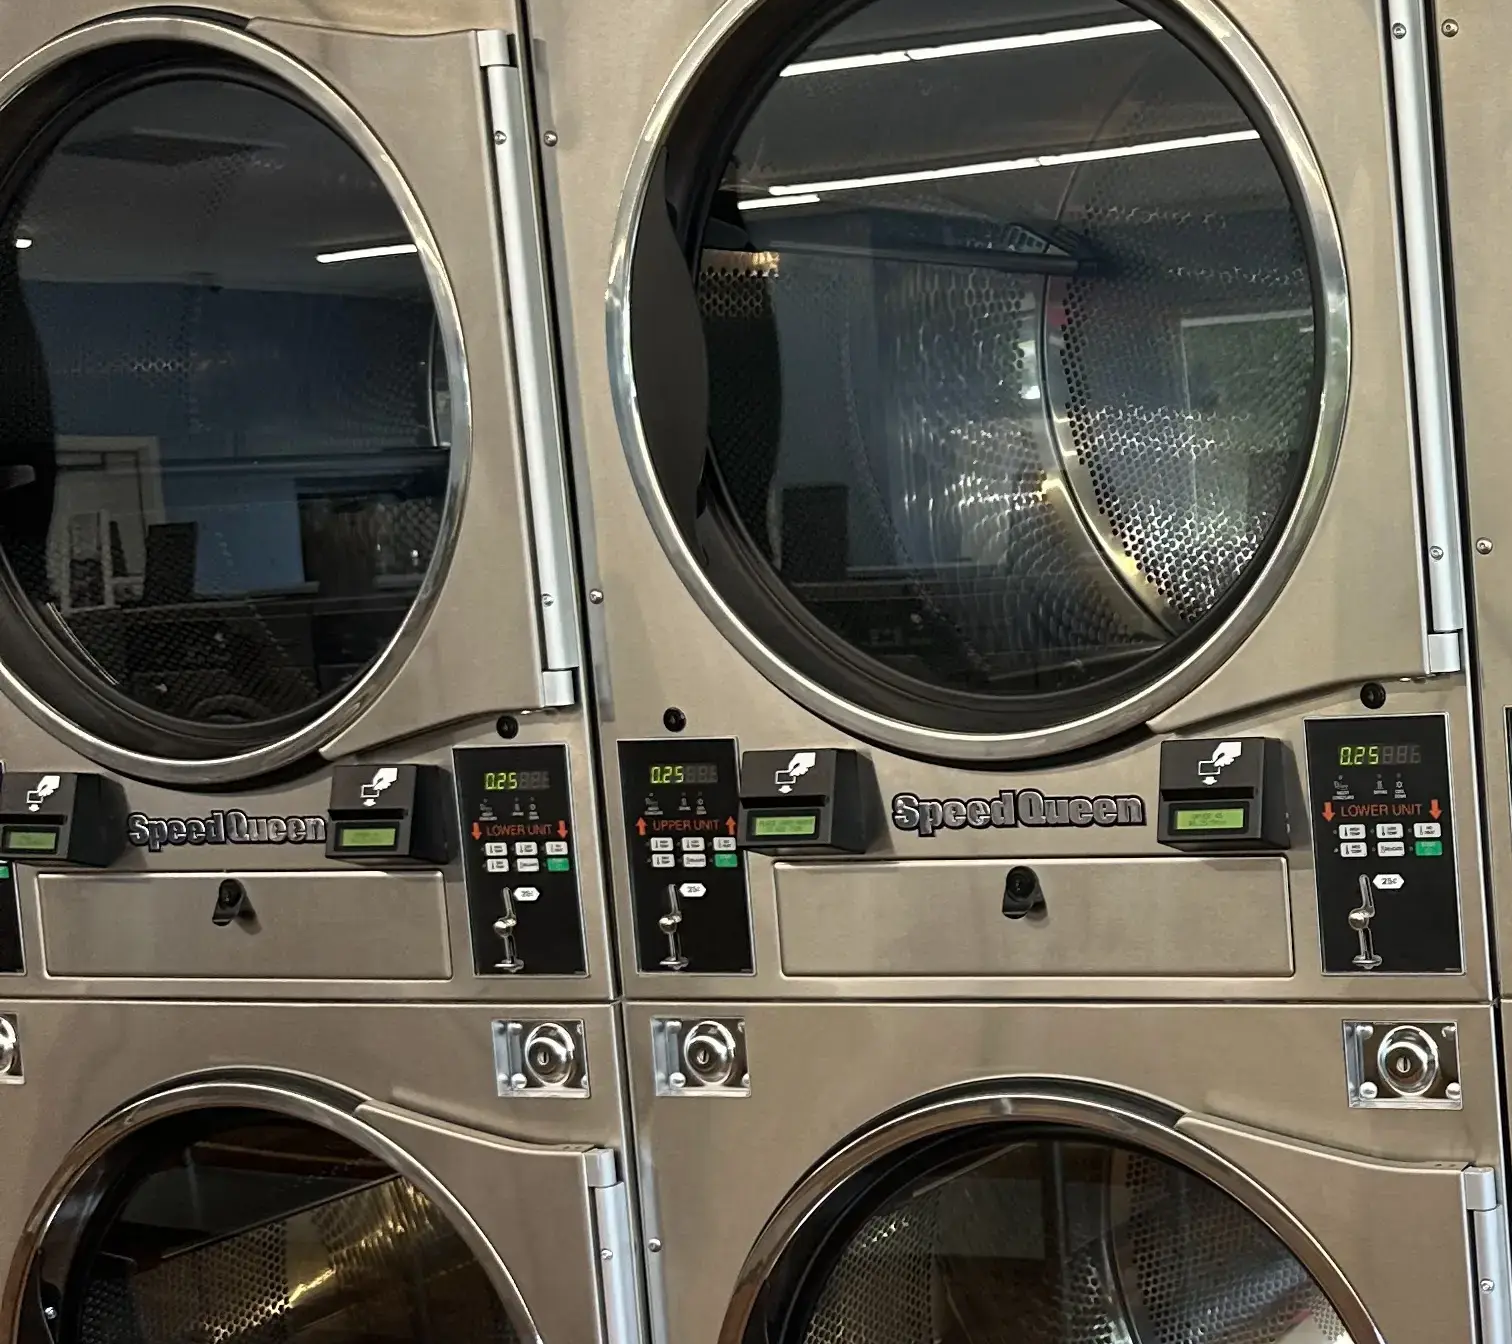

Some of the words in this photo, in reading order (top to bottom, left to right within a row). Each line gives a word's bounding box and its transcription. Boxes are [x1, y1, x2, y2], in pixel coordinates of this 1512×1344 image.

[1339, 746, 1379, 766] 0.25
[1340, 804, 1389, 818] LOWER
[1392, 803, 1423, 816] UNIT
[486, 824, 526, 837] LOWER
[528, 824, 553, 835] UNIT
[652, 819, 692, 831] UPPER
[694, 819, 720, 831] UNIT
